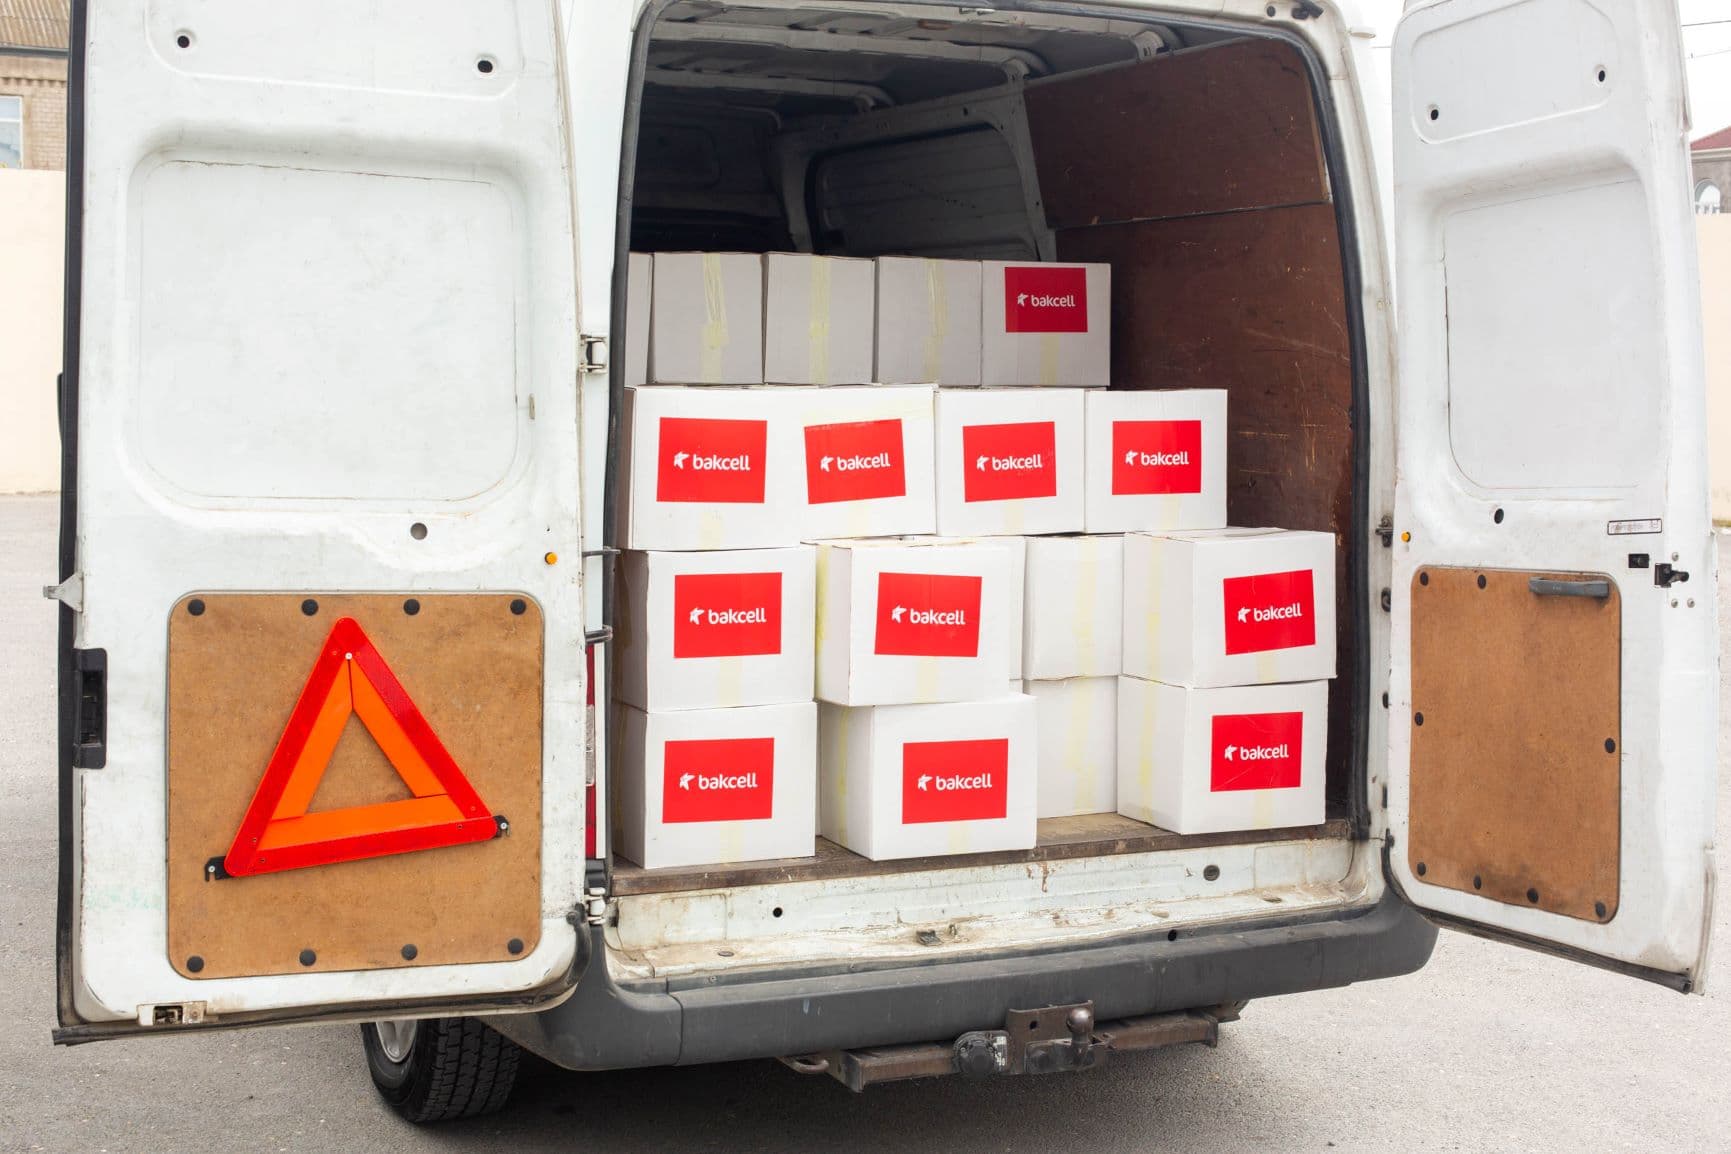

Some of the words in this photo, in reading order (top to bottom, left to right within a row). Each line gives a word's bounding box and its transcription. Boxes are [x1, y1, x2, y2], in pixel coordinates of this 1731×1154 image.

[1031, 295, 1075, 307] bakcell
[692, 453, 751, 471] bakcell
[836, 452, 891, 472] bakcell
[991, 453, 1043, 471] bakcell
[1140, 450, 1190, 466] bakcell
[707, 607, 767, 625] bakcell
[909, 607, 966, 626] bakcell
[1253, 602, 1302, 622] bakcell
[1240, 743, 1289, 761] bakcell
[697, 772, 758, 791] bakcell
[935, 772, 993, 791] bakcell
